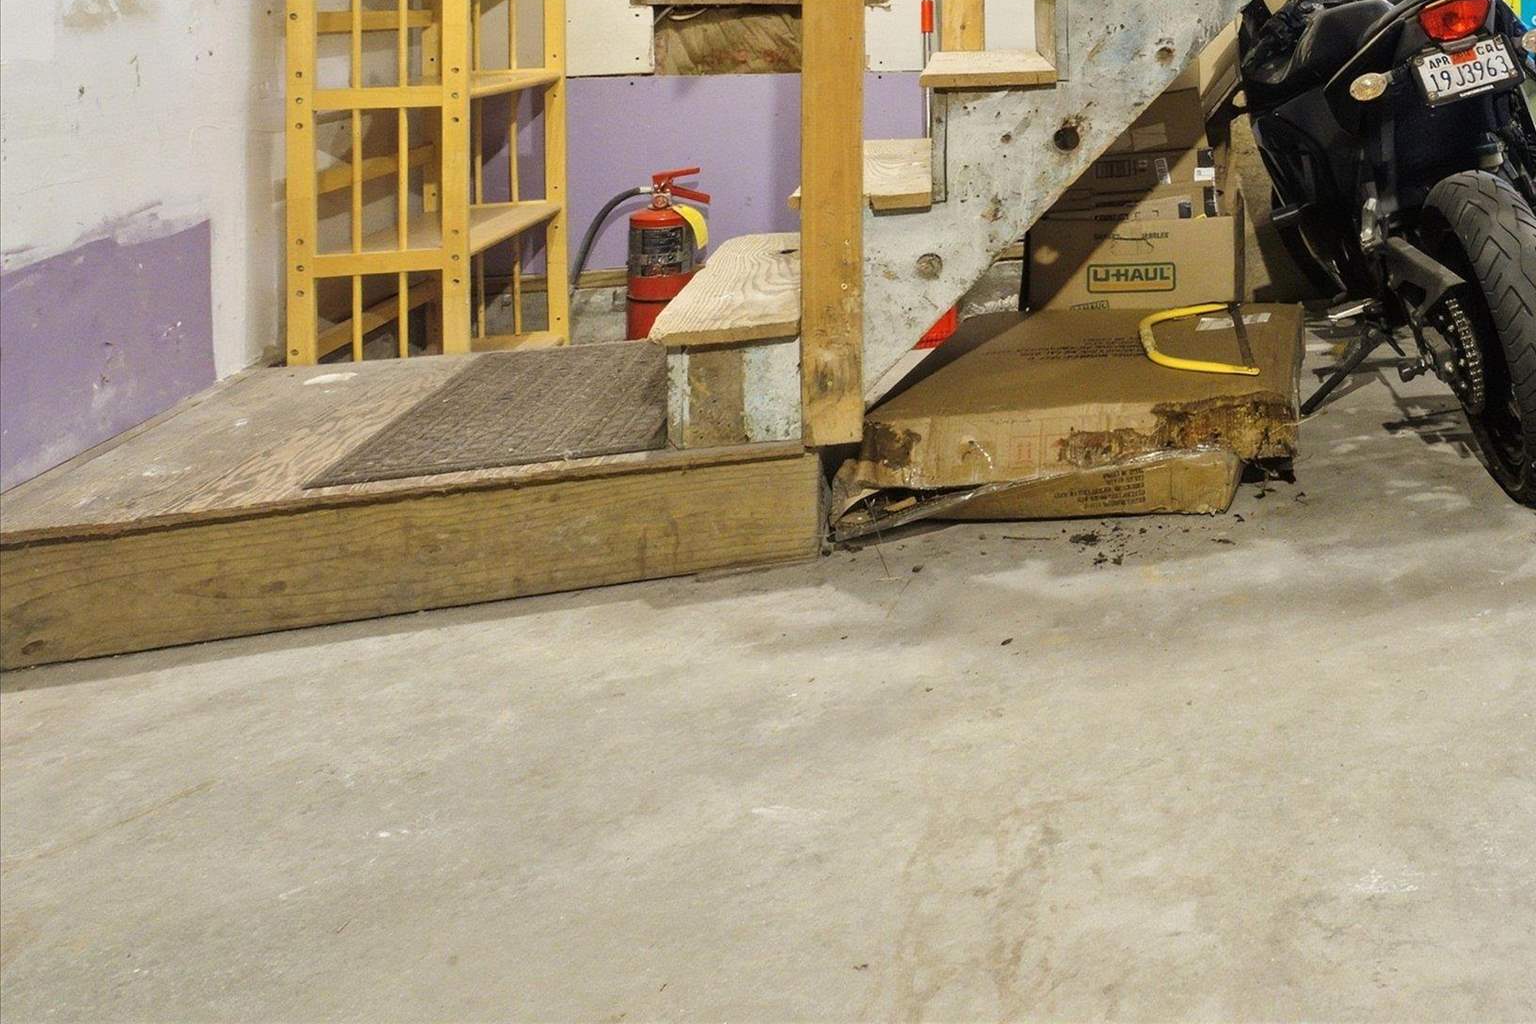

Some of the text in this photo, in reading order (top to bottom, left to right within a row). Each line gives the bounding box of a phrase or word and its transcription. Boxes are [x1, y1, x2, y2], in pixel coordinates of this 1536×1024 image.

[1428, 56, 1451, 70] APR
[1475, 41, 1504, 56] CAL
[1430, 55, 1509, 93] 19J3963
[1092, 267, 1171, 283] U-HAUL
